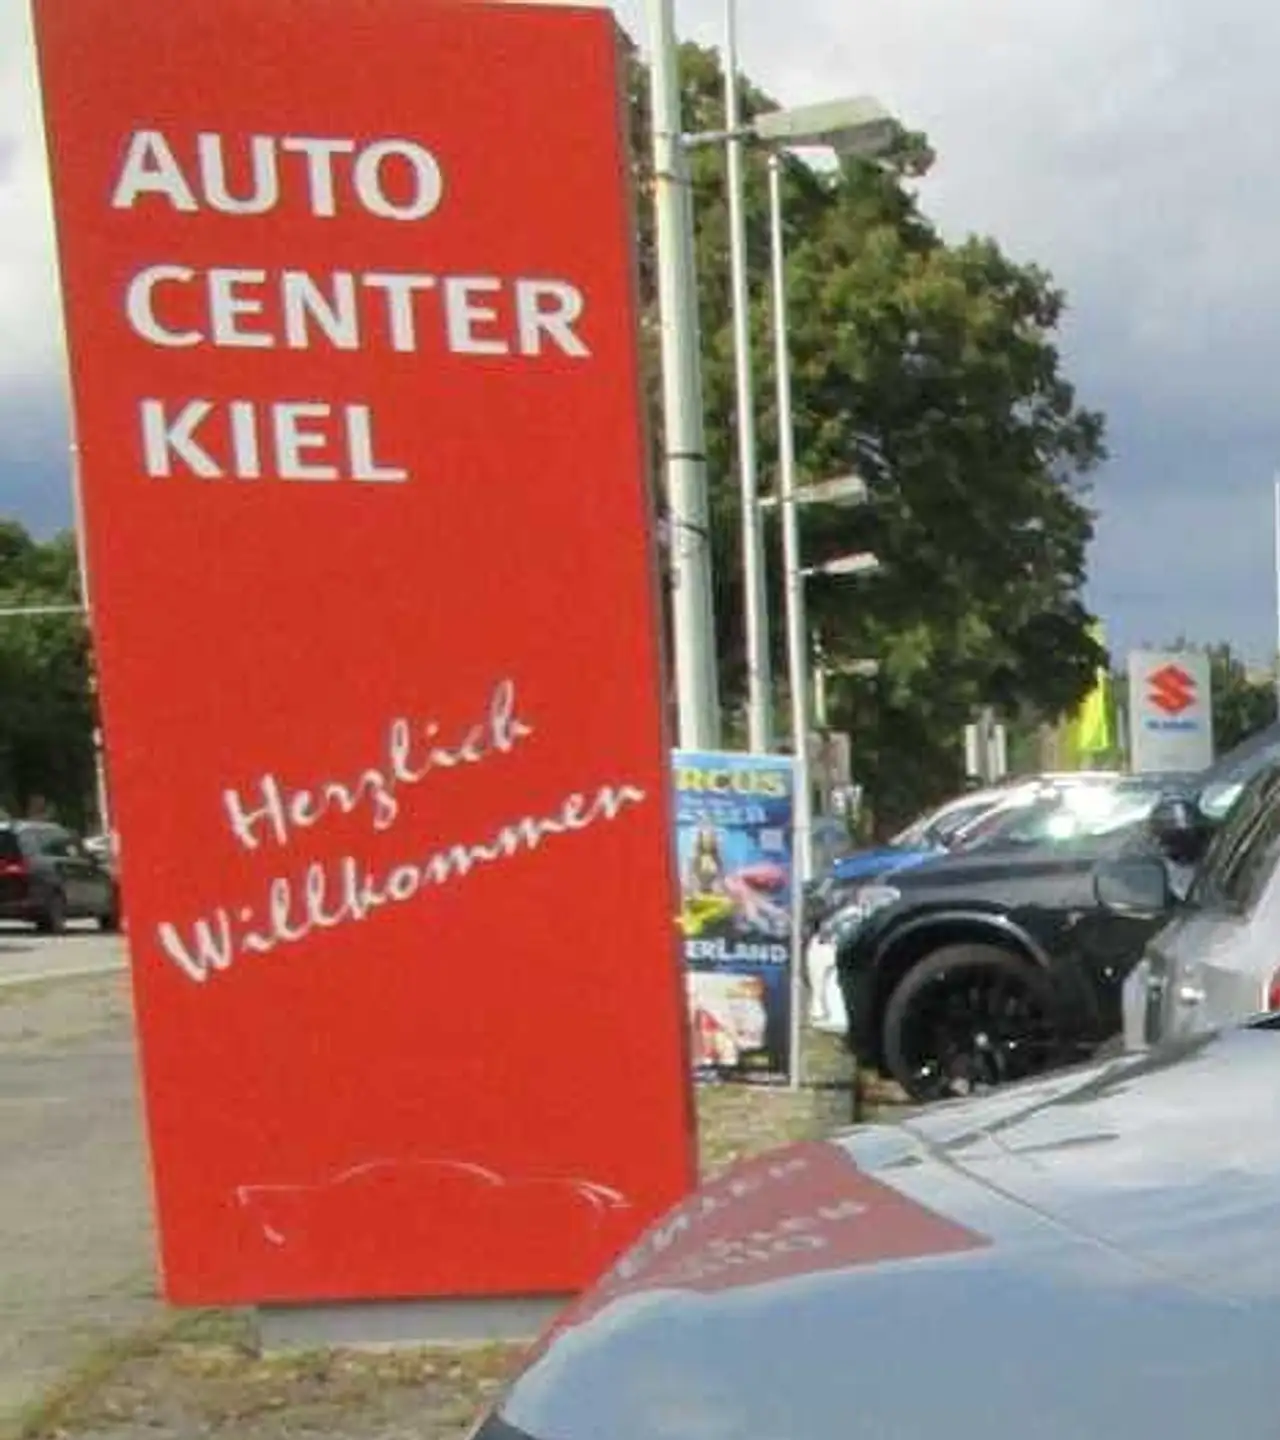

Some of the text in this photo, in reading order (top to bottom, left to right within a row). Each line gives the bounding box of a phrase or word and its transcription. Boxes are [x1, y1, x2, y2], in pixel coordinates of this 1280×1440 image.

[112, 130, 443, 221] AUTO
[125, 264, 590, 360] CENTER
[141, 398, 408, 483] KIEL
[223, 679, 533, 852] Herzlich
[158, 783, 645, 983] Willkommen
